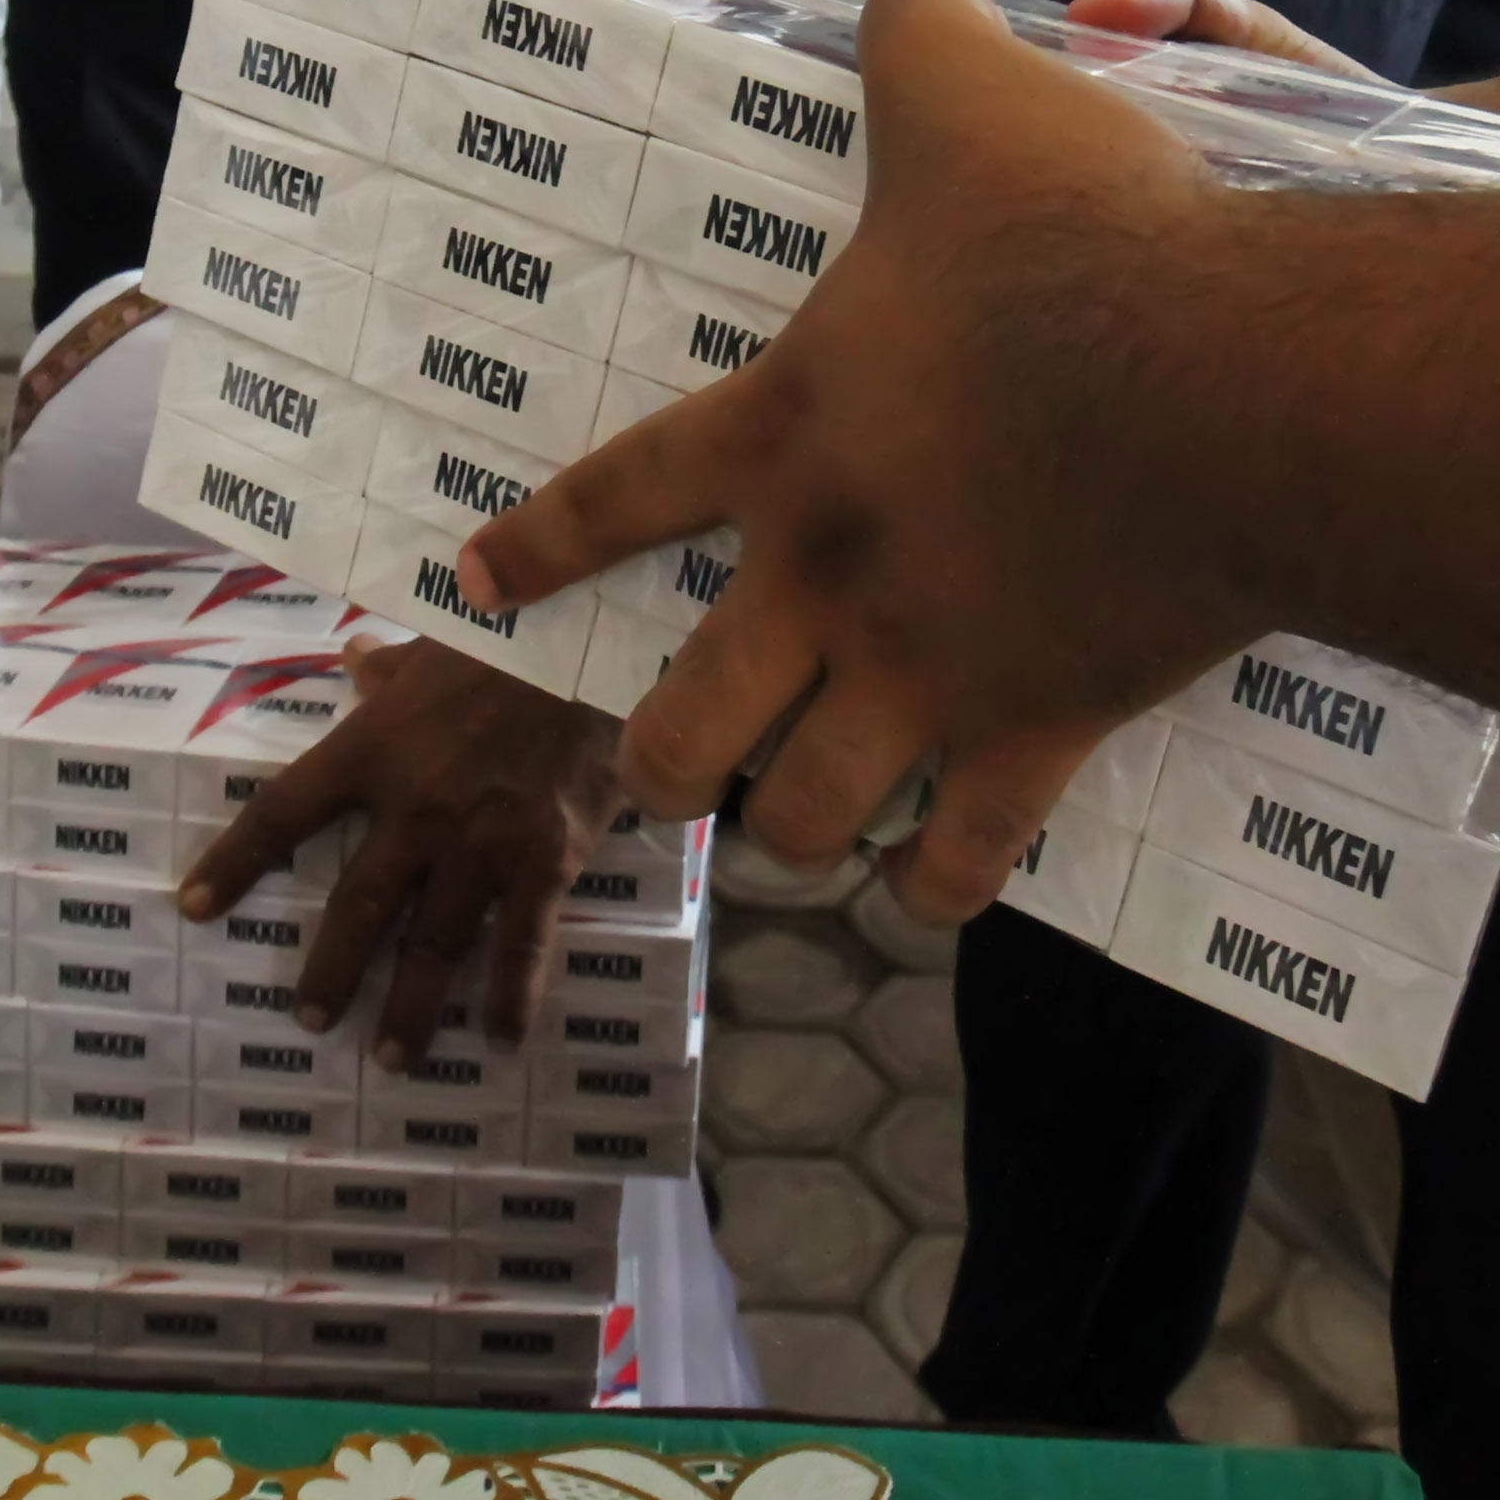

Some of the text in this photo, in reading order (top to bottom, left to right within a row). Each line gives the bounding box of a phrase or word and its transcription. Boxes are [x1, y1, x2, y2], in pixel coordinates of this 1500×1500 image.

[239, 37, 337, 108] NIKKEN
[457, 111, 567, 188] NIKKEN
[731, 76, 856, 158] NIKKEN
[224, 145, 324, 216] NIKKEN
[442, 227, 552, 304] NIKKEN
[703, 194, 826, 278] NIKKEN
[203, 246, 300, 320] NIKKEN
[419, 335, 528, 413] NIKKEN
[688, 313, 771, 371] NIKK
[220, 362, 317, 438] NIKKEN
[199, 463, 296, 541] NIKKEN
[676, 548, 735, 605] NIK
[1231, 655, 1386, 758] NIKKEN
[57, 758, 130, 791] NIKKEN
[55, 825, 128, 855] NIKKEN
[1242, 795, 1396, 899] NIKKEN
[59, 898, 131, 930] NIKKEN
[227, 917, 300, 948] NIKKEN
[58, 963, 130, 994] NIKKEN
[1205, 917, 1354, 1023] NIKKEN
[74, 1029, 146, 1060] NIKKEN
[240, 1043, 312, 1074] NIKKEN
